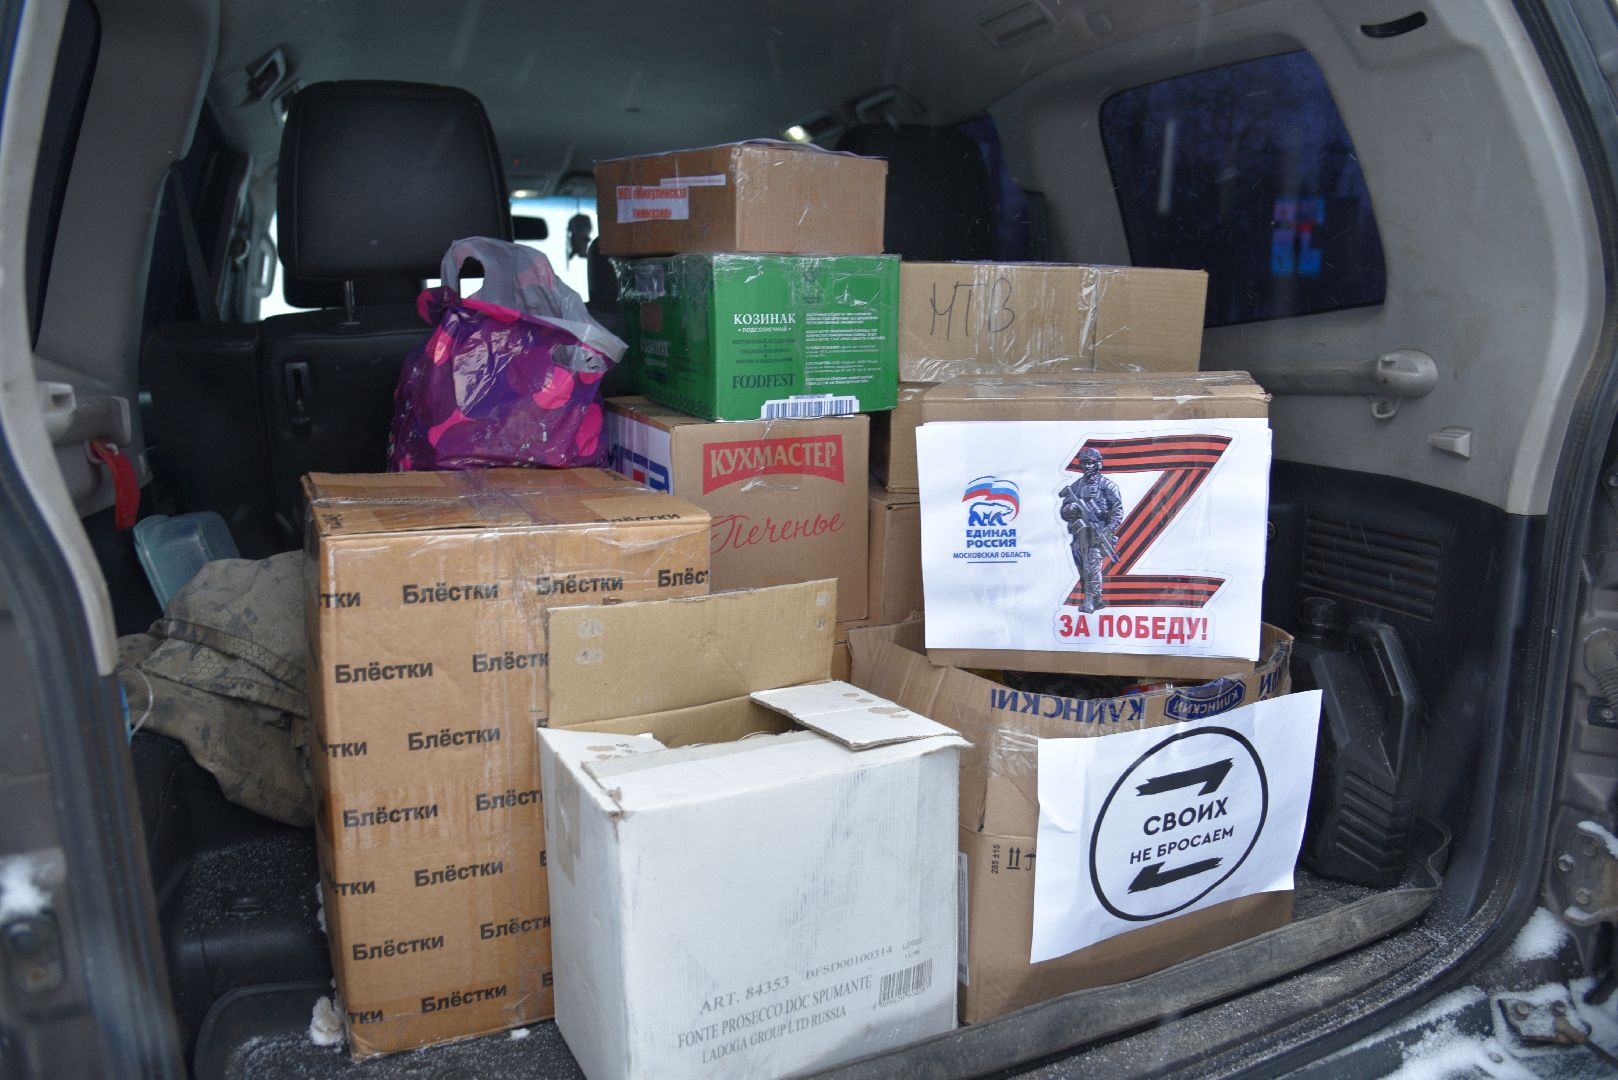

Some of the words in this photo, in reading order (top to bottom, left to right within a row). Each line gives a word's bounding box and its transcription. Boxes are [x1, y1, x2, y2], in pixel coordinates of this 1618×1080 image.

[733, 313, 796, 325] КОЗИНАК
[732, 373, 796, 389] FOODFEST
[710, 440, 837, 479] КУХМАСТЕР
[711, 512, 846, 555] Печенье
[966, 528, 1017, 539] ЕДИНАЯ
[966, 538, 1017, 549] РОССИЯ
[953, 551, 999, 560] МОСКОВСКАЯ
[1000, 550, 1032, 559] ОБЛАСТЬ
[402, 582, 499, 605] Блёстки
[536, 574, 624, 596] Блёстки
[1059, 614, 1090, 637] ЗА
[1099, 614, 1209, 645] ПОБЕДУ!
[334, 661, 434, 684] Блёстки
[991, 687, 1145, 724] КЛИНСКИ
[1173, 688, 1239, 715] КЛИНСКИЙ
[408, 727, 501, 751] Блёстки
[343, 802, 439, 829] Блёстки
[1143, 796, 1229, 836] СВОИХ
[1129, 847, 1152, 864] НЕ
[1157, 825, 1234, 858] БРОСАЕМ
[414, 859, 504, 888] Блёстки
[352, 934, 445, 961] Блёстки
[421, 983, 507, 1014] Блёстки
[700, 991, 740, 1015] ART.
[745, 975, 790, 1002] 84353
[678, 1023, 720, 1049] FONTE
[721, 1003, 783, 1034] PROSECCO
[785, 994, 811, 1016] DOC
[812, 974, 873, 1006] SPUMANTE
[701, 1038, 748, 1065] LADOGA
[749, 1022, 788, 1047] GROUP
[788, 1016, 810, 1034] LTD
[811, 1005, 847, 1026] RUSSIA
